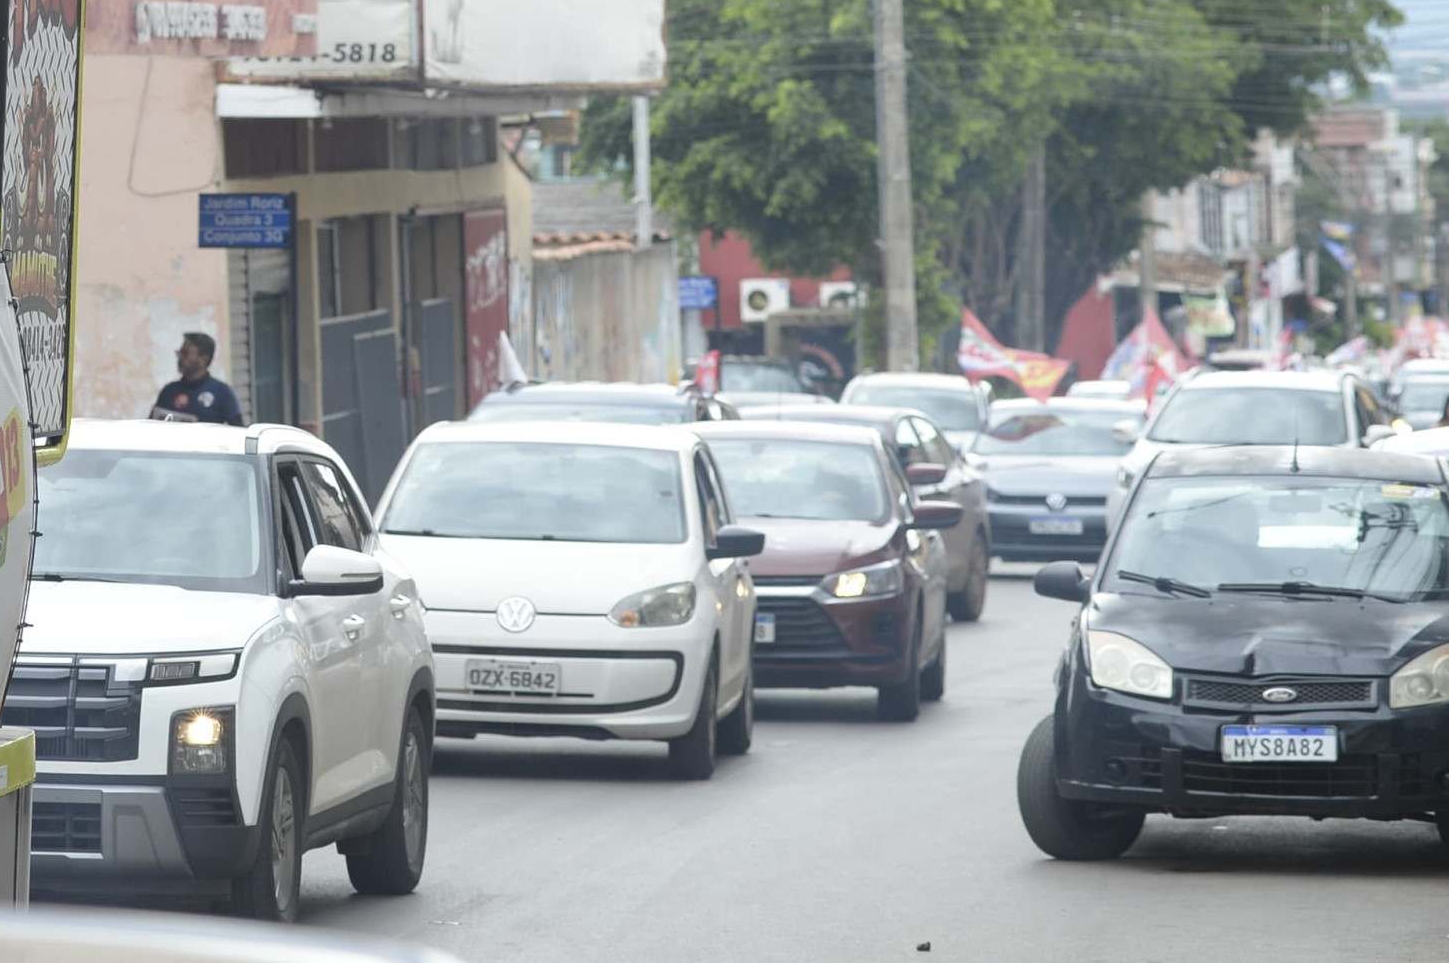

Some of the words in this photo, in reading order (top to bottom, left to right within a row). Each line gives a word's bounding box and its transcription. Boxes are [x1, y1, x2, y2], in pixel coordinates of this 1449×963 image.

[215, 213, 262, 227] Quadra
[204, 230, 262, 245] Conjunto
[1233, 738, 1324, 757] MYS8A82
